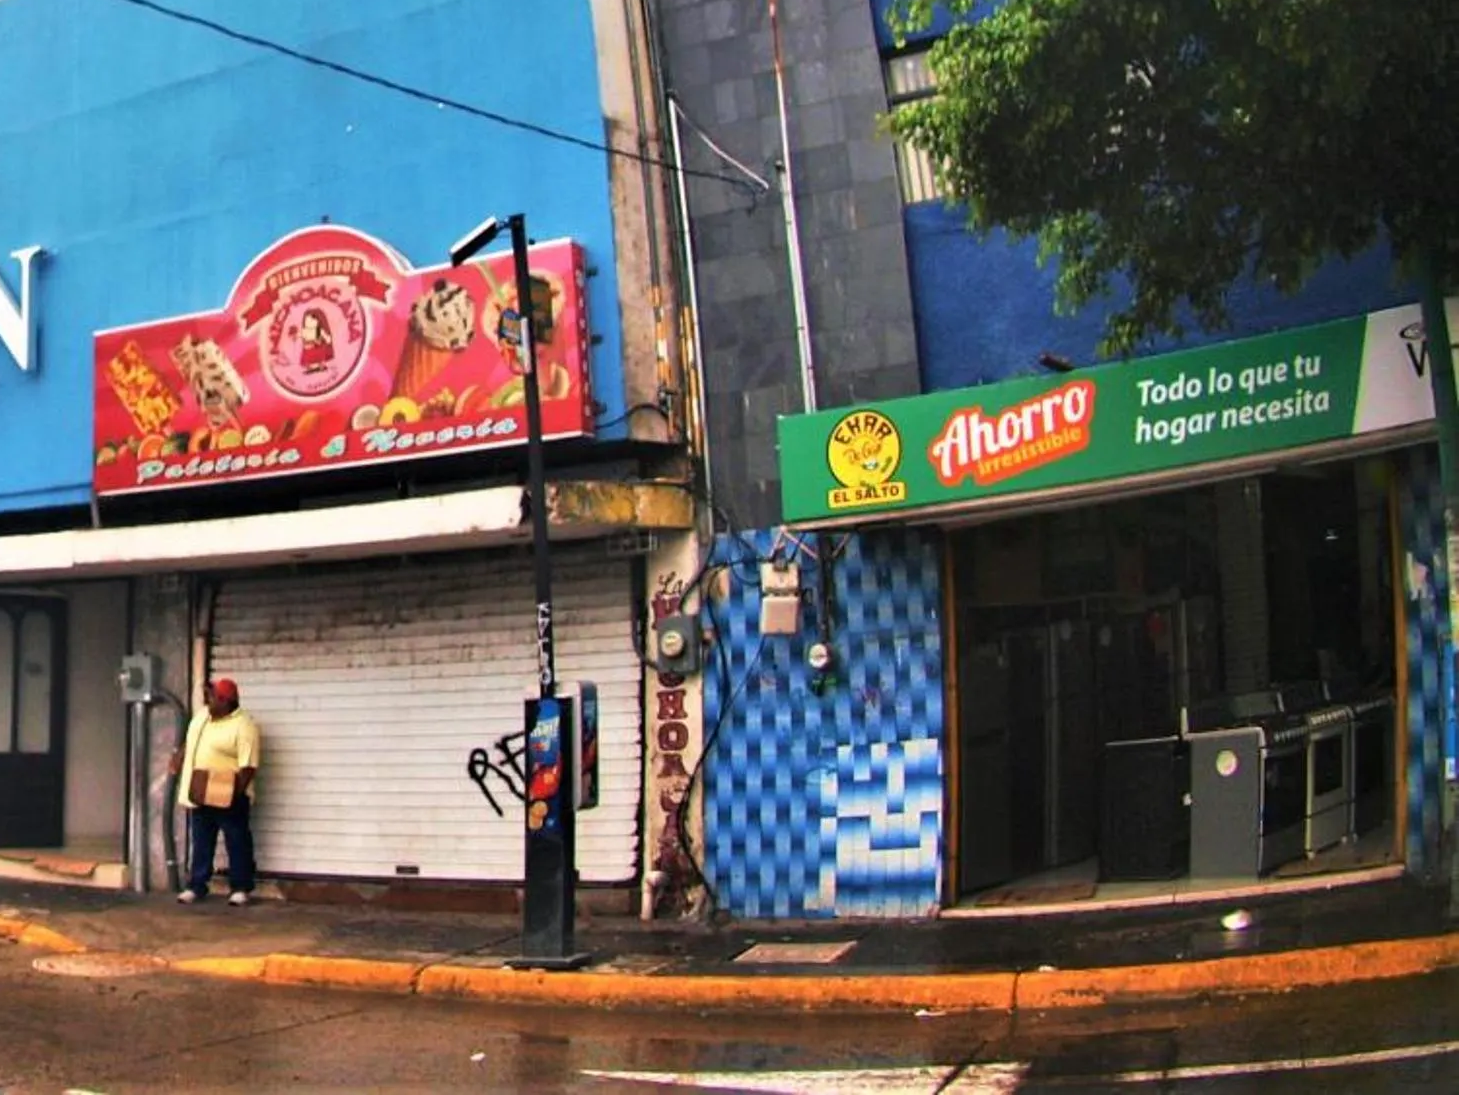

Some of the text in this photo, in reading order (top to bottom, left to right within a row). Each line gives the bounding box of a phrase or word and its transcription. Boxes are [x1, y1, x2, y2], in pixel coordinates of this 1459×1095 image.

[268, 259, 360, 291] BIENVENIDOS
[1137, 354, 1322, 407] Todo lo que tu
[932, 386, 1089, 478] Ahorro
[1135, 388, 1331, 445] hogar necesita
[834, 485, 900, 504] EL SALTO
